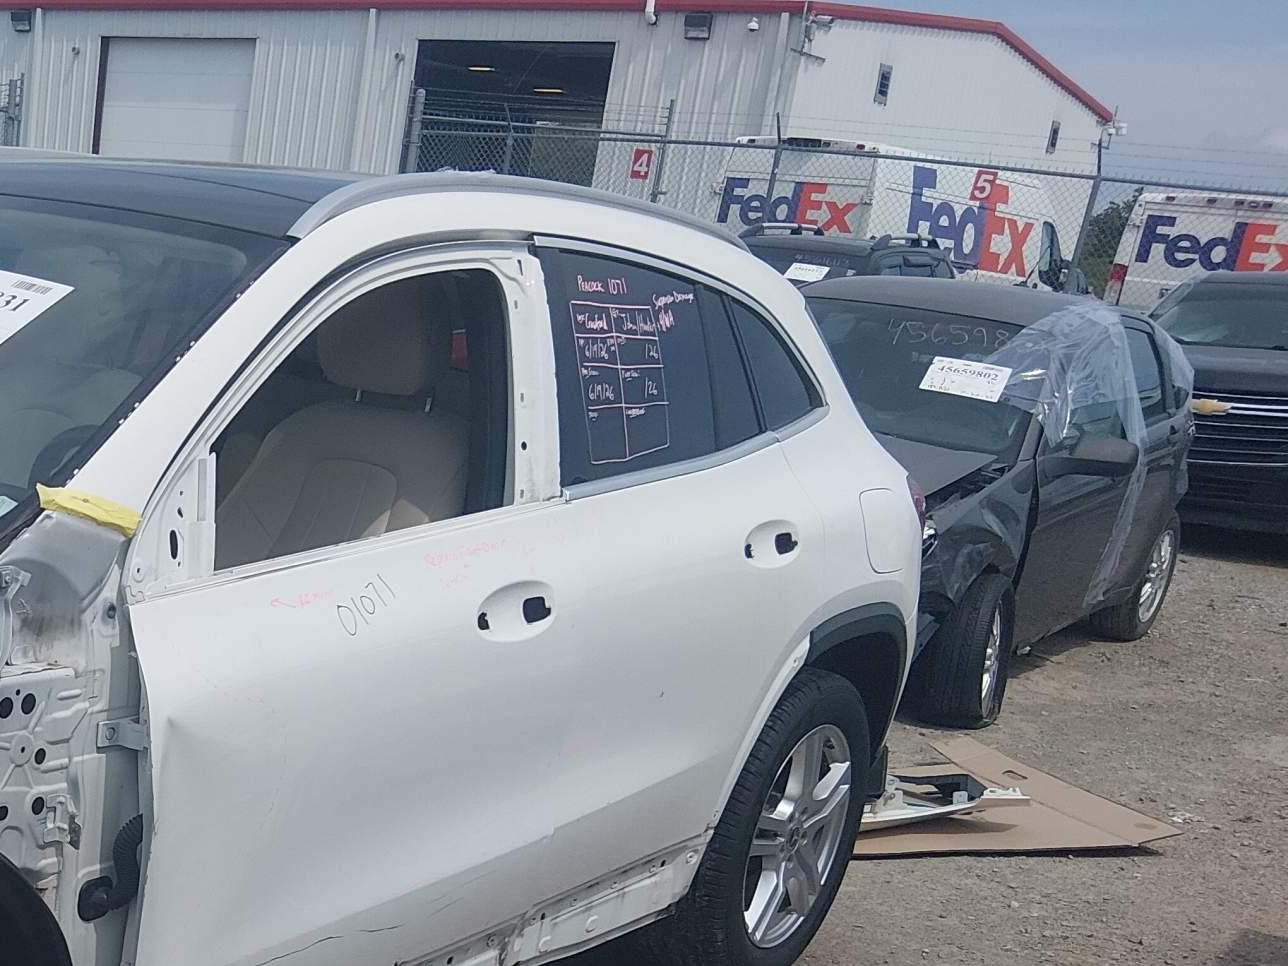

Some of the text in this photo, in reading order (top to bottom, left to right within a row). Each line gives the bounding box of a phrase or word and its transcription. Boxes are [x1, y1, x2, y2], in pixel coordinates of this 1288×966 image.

[633, 153, 649, 176] 4
[716, 176, 857, 234] FedEx
[974, 174, 994, 198] 5
[906, 165, 1035, 277] FedEx
[937, 365, 1000, 382] 45659802
[336, 573, 397, 637] 01071
